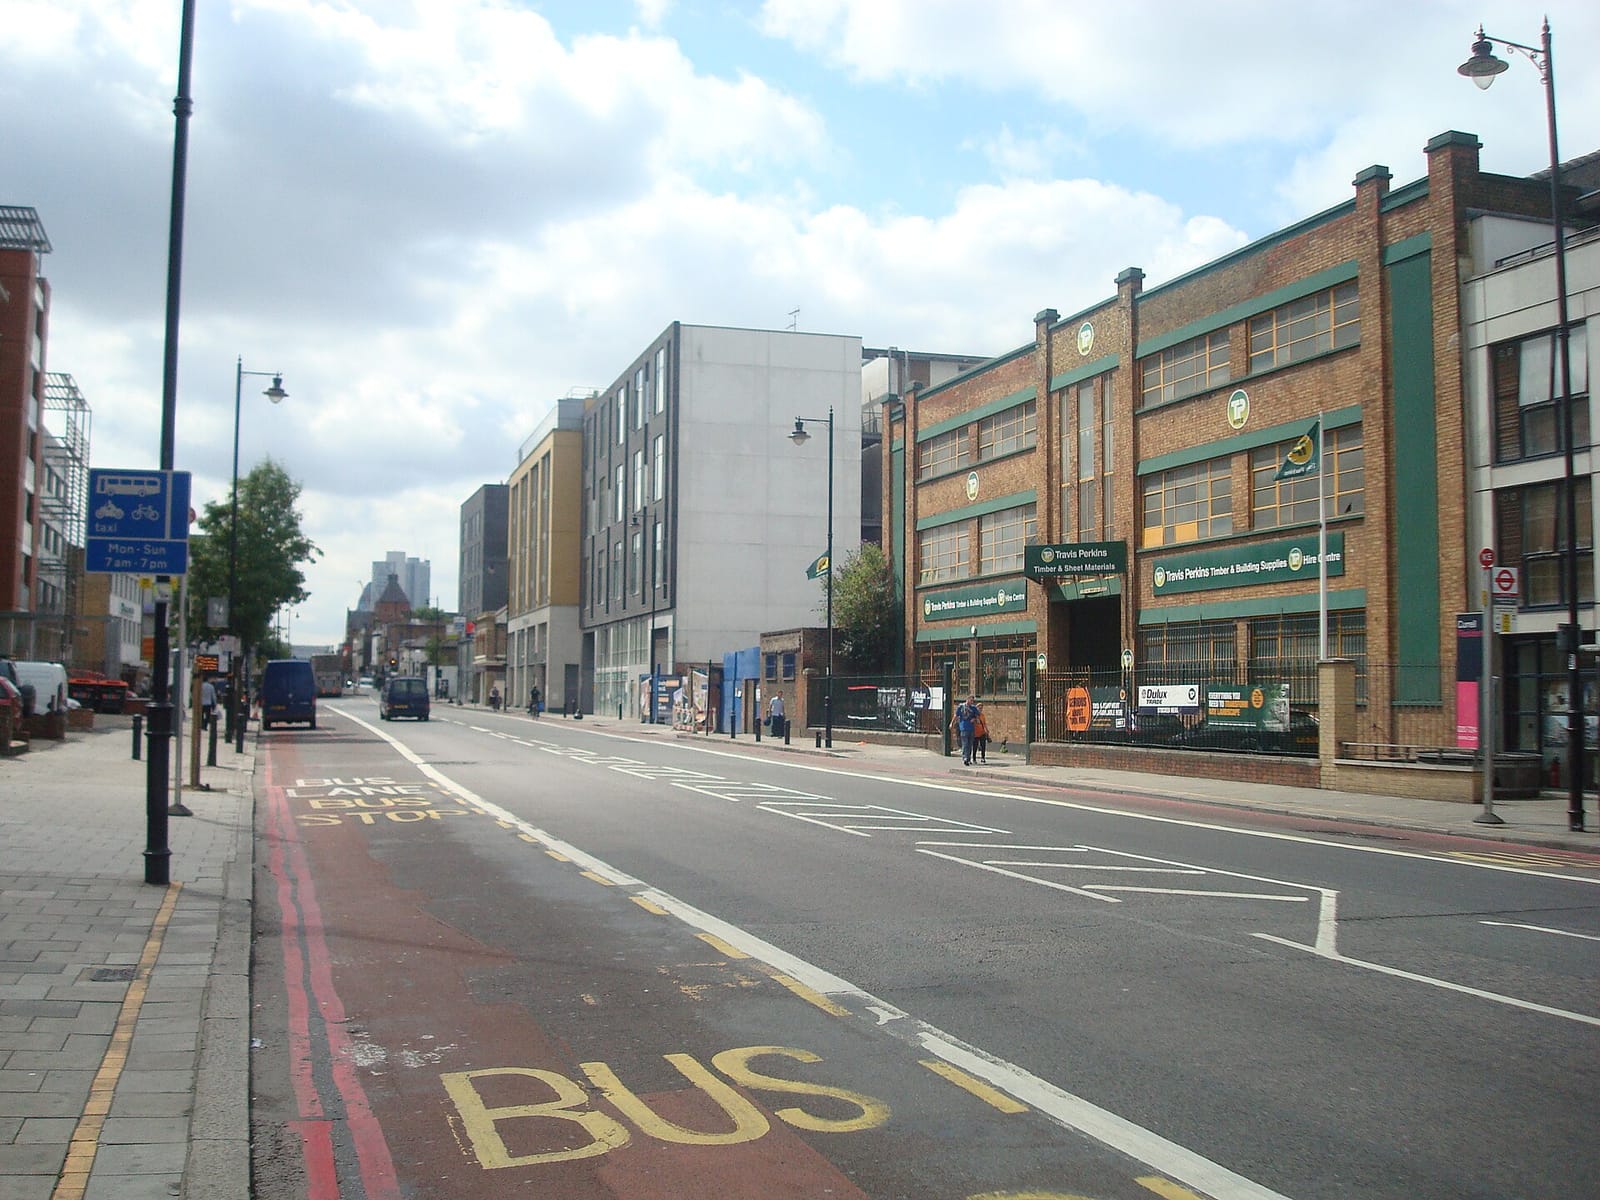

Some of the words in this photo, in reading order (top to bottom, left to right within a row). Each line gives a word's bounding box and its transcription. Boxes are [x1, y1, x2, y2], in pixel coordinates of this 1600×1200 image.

[95, 522, 117, 532] taxi
[108, 543, 134, 554] Mon
[143, 544, 166, 555] Sun
[1055, 549, 1077, 559] Travis
[1078, 548, 1108, 558] Perkins
[104, 557, 131, 567] 7am
[141, 558, 167, 569] 7pm
[1033, 565, 1056, 573] Timber
[1064, 564, 1083, 572] Sheet
[1084, 563, 1116, 571] Materials
[1165, 569, 1185, 582] Travis
[1184, 566, 1210, 580] Perkins
[1210, 566, 1229, 577] Timber
[1230, 564, 1235, 574] &
[1235, 562, 1260, 573] Building
[1260, 558, 1288, 571] Supplies
[1303, 555, 1317, 565] Hire
[1317, 552, 1341, 562] Cntre
[941, 601, 956, 610] Perkins
[983, 596, 997, 606] Supplies
[1012, 593, 1025, 601] Centre
[1146, 688, 1168, 699] Dulux
[295, 776, 396, 787] BUS
[286, 785, 432, 798] LANE
[309, 797, 432, 809] BUS
[295, 809, 469, 826] STOP
[440, 1046, 891, 1170] BUS
